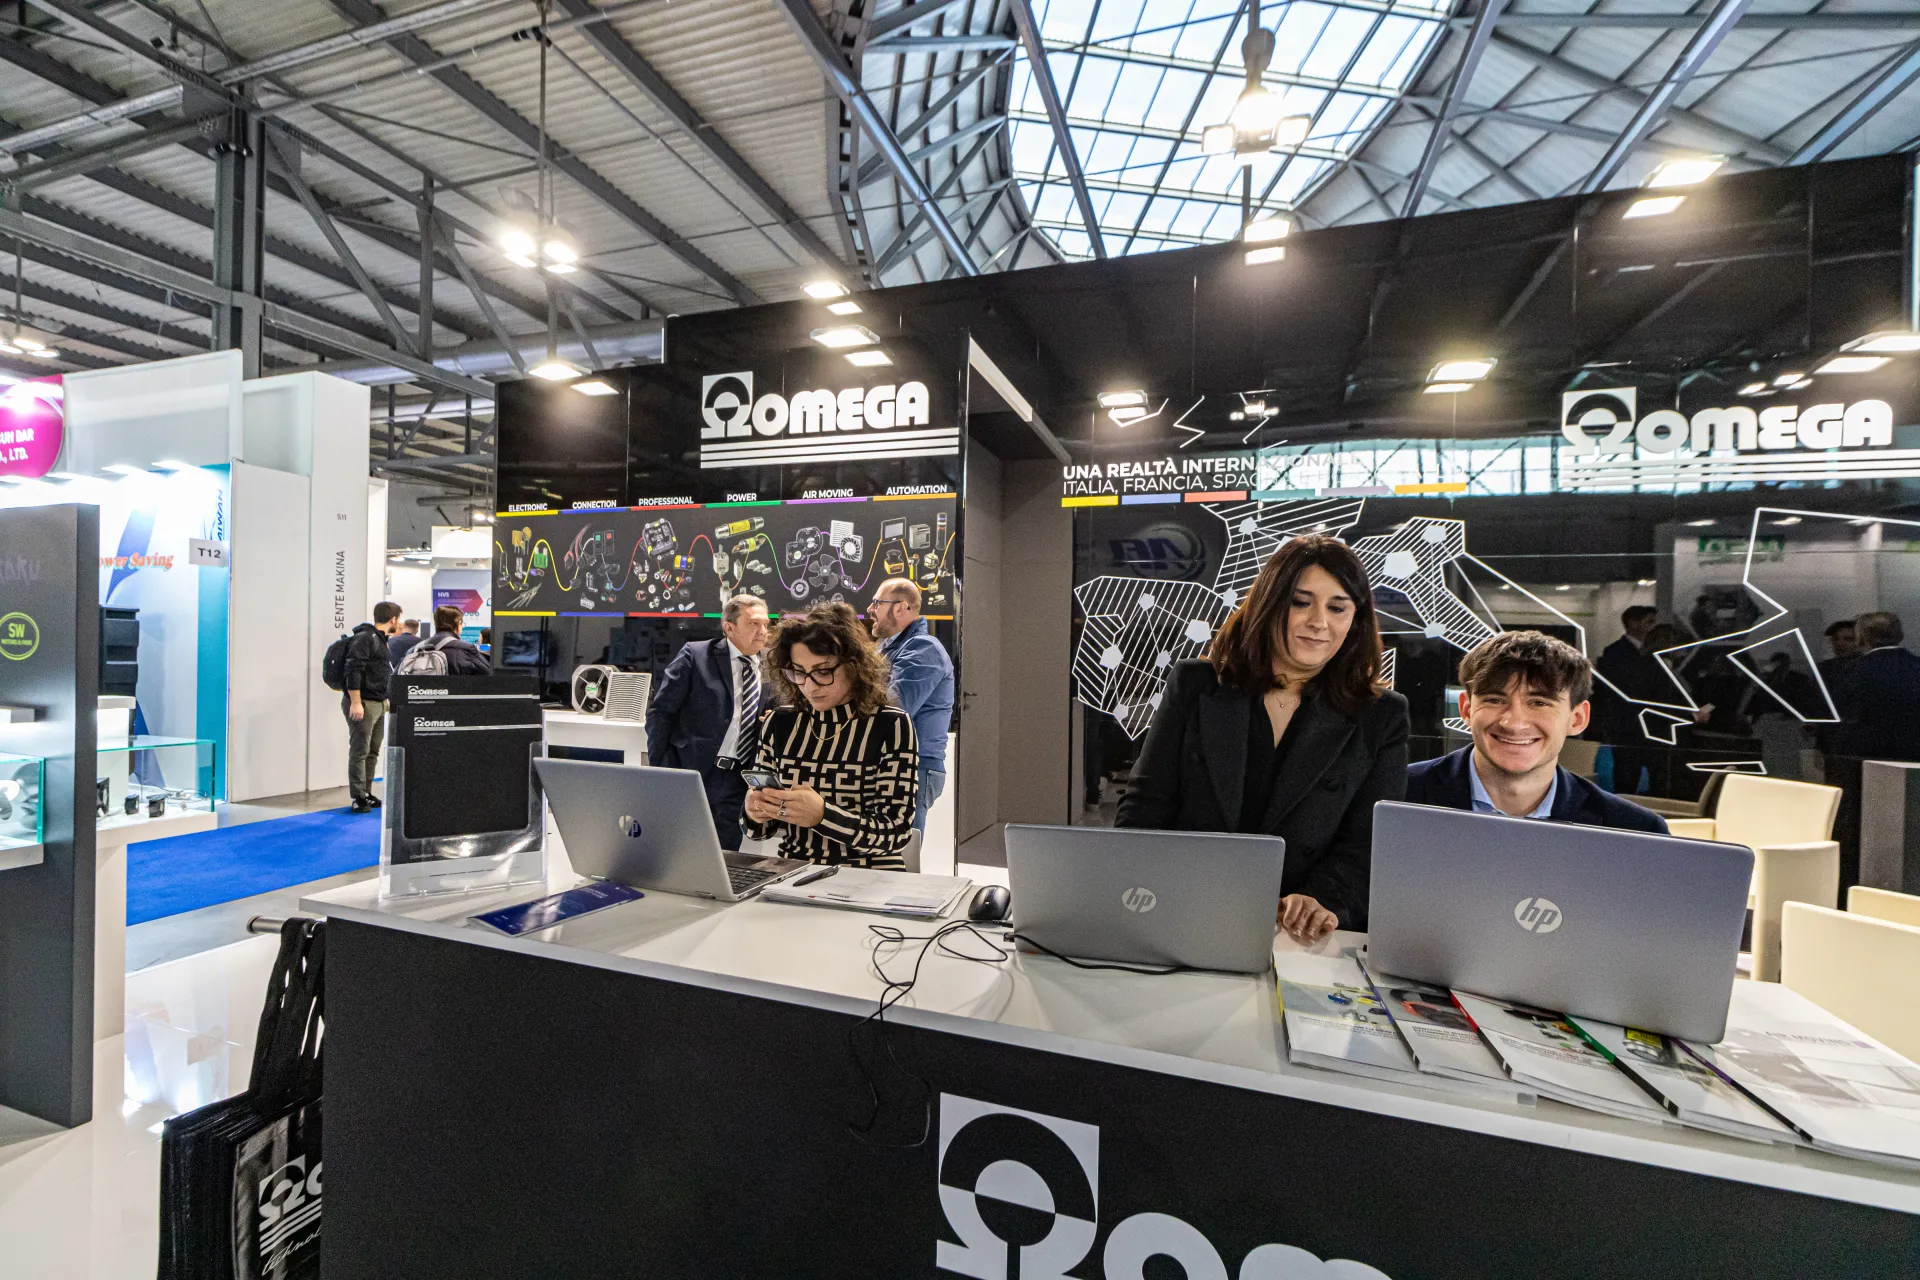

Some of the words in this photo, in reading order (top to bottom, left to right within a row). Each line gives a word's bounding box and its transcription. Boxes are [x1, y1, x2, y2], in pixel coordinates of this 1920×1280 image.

[752, 381, 929, 436] OMEGA
[1636, 399, 1893, 453] OMEGA
[1063, 464, 1102, 480] UNA
[1107, 457, 1178, 477] REALTÀ
[886, 485, 947, 495] AUTOMATION
[1063, 479, 1118, 495] ITALIA,
[1123, 474, 1208, 492] FRANCIA,
[638, 496, 694, 506] PROFESSIONAL
[727, 493, 757, 502] POWER
[802, 490, 817, 499] AIR
[819, 488, 853, 498] MOVING
[508, 503, 548, 512] ELECTRONIC
[572, 500, 617, 509] CONNECTION
[131, 552, 174, 569] Saving
[197, 547, 221, 559] T12
[335, 551, 345, 592] MAKINA
[334, 595, 345, 629] SENTE
[8, 622, 25, 638] SW
[1122, 887, 1157, 912] hp
[1516, 897, 1562, 933] hp
